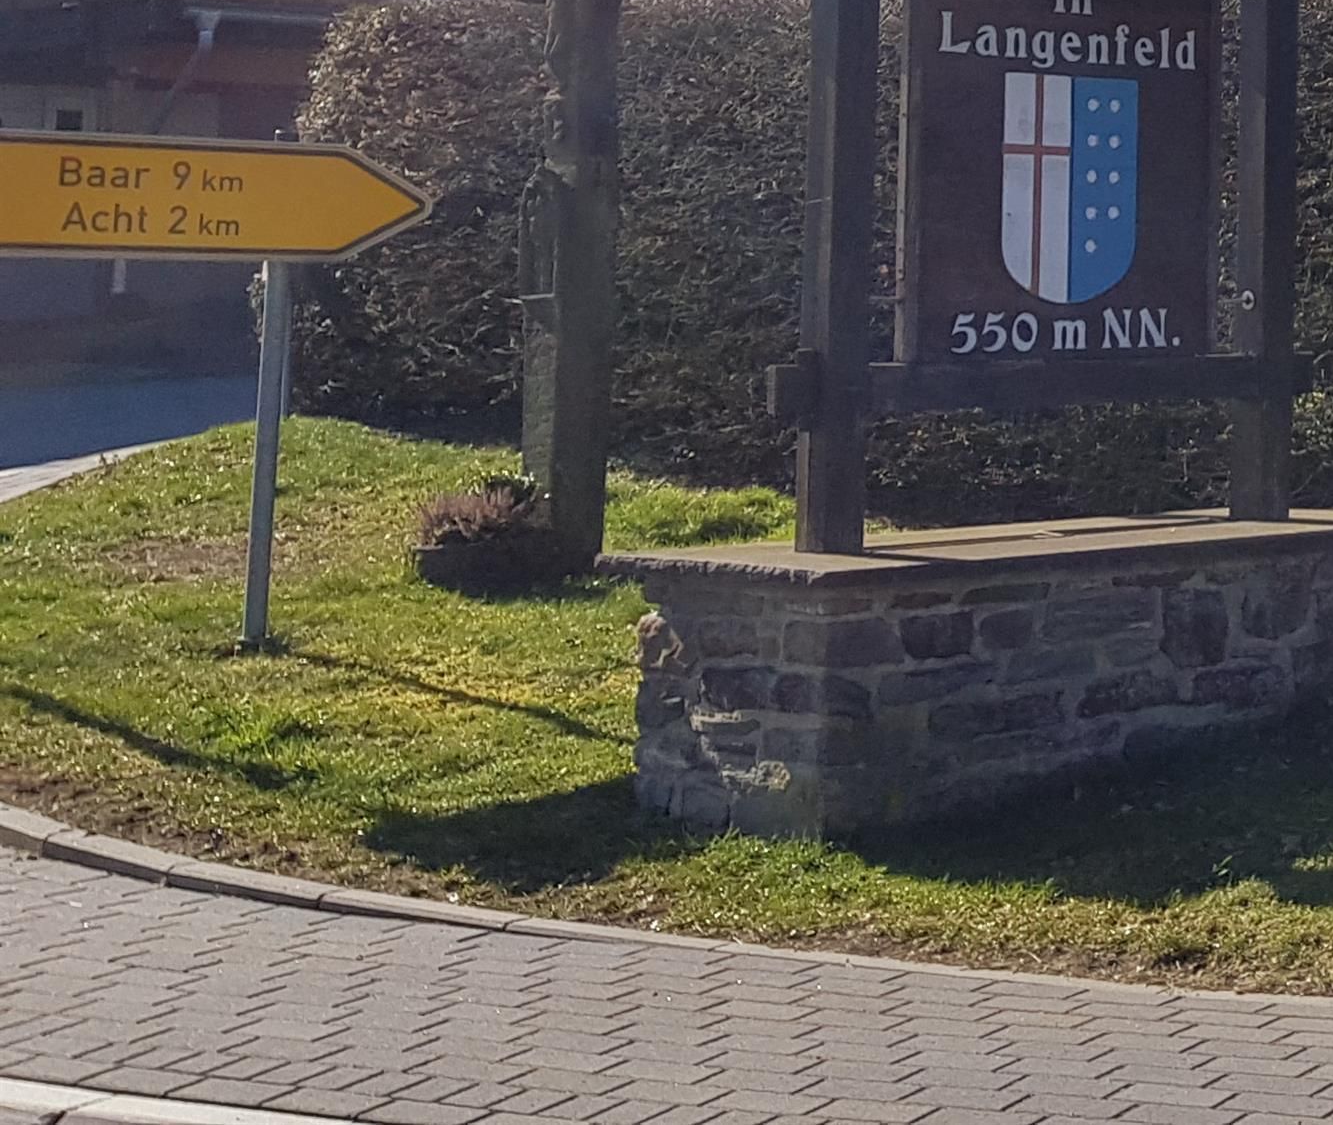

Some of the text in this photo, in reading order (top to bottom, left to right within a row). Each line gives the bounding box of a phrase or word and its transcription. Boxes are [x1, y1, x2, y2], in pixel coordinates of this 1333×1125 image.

[938, 11, 1196, 70] Langenfeld
[58, 156, 243, 192] Baar 9 km
[61, 202, 240, 236] Acht 2 km
[950, 307, 1181, 354] 550 m NN.
